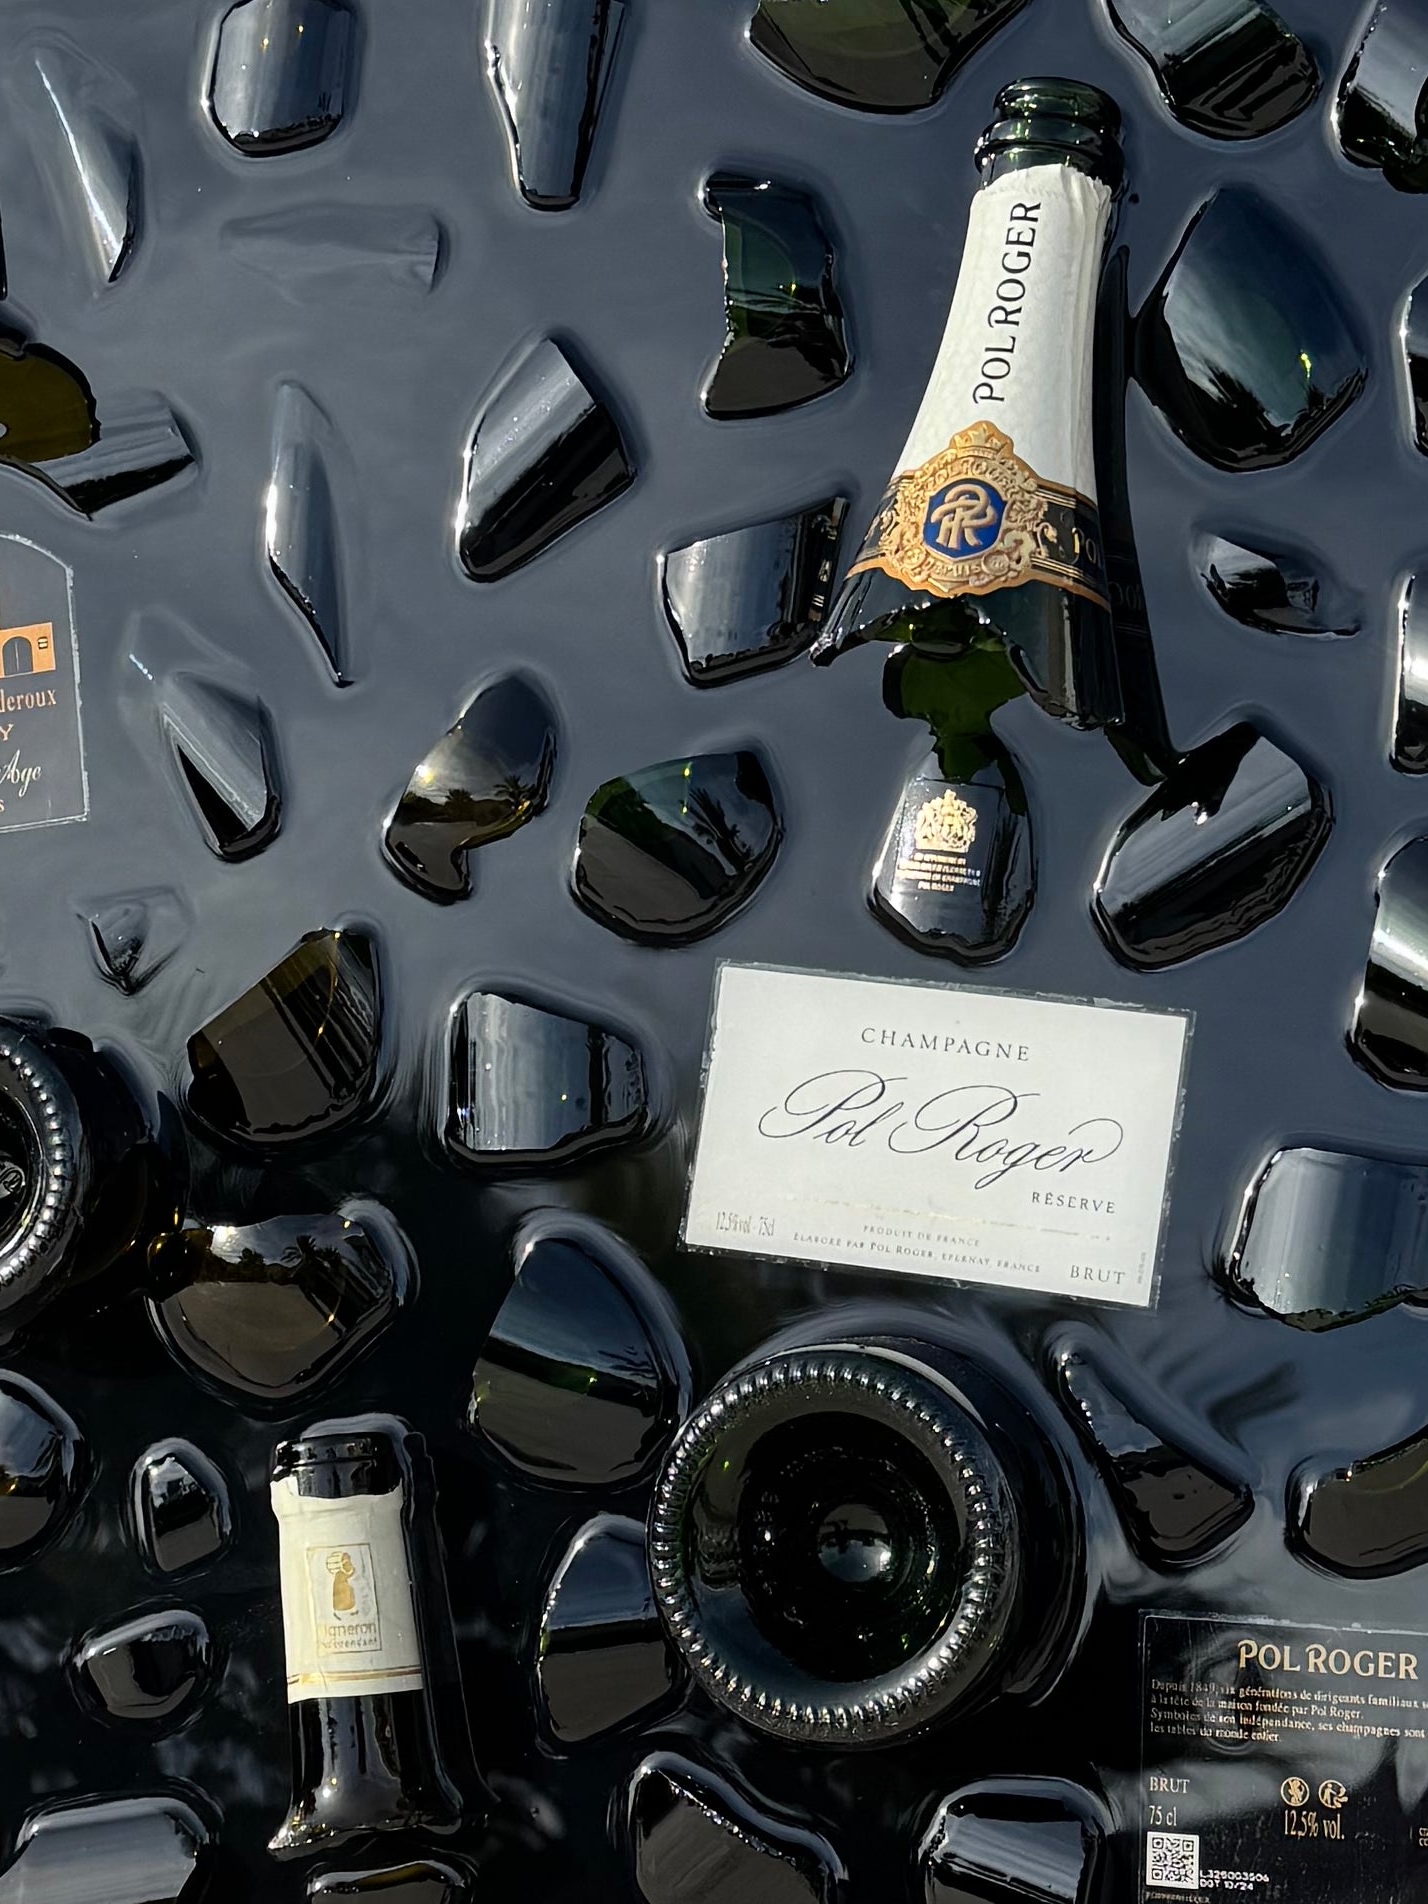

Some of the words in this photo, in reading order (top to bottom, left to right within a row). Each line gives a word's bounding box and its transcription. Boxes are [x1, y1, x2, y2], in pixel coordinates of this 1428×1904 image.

[988, 202, 1041, 328] ROGER
[973, 336, 1016, 404] POL
[861, 1027, 1031, 1062] CHAMPAGNE
[759, 1069, 908, 1147] Pol
[889, 1085, 1124, 1190] Roger
[864, 1225, 913, 1239] PRODUIT
[917, 1231, 932, 1241] DE
[937, 1233, 980, 1247] FRANCE
[870, 1242, 891, 1253] POL
[997, 1259, 1040, 1273] FRANCE
[1071, 1264, 1126, 1285] BRUT
[1238, 1640, 1300, 1672] POL
[1306, 1643, 1418, 1680] ROGER
[1152, 1679, 1187, 1693] Depuis
[1239, 1686, 1297, 1701] générations
[1300, 1689, 1312, 1701] de
[1314, 1690, 1365, 1705] dirigeants
[1367, 1694, 1419, 1709] familiaux
[1151, 1707, 1201, 1721] Symboles
[1337, 1721, 1401, 1738] champagnes
[1404, 1727, 1425, 1739] sont
[1255, 1700, 1290, 1713] fondée
[1292, 1705, 1308, 1717] par
[1311, 1704, 1327, 1716] Pol
[1330, 1705, 1364, 1721] Roger.
[1150, 1776, 1190, 1794] BRUT
[1149, 1806, 1163, 1825] 75
[1166, 1807, 1177, 1826] cl
[1284, 1810, 1319, 1840] 12,5%
[1323, 1814, 1345, 1840] vol.
